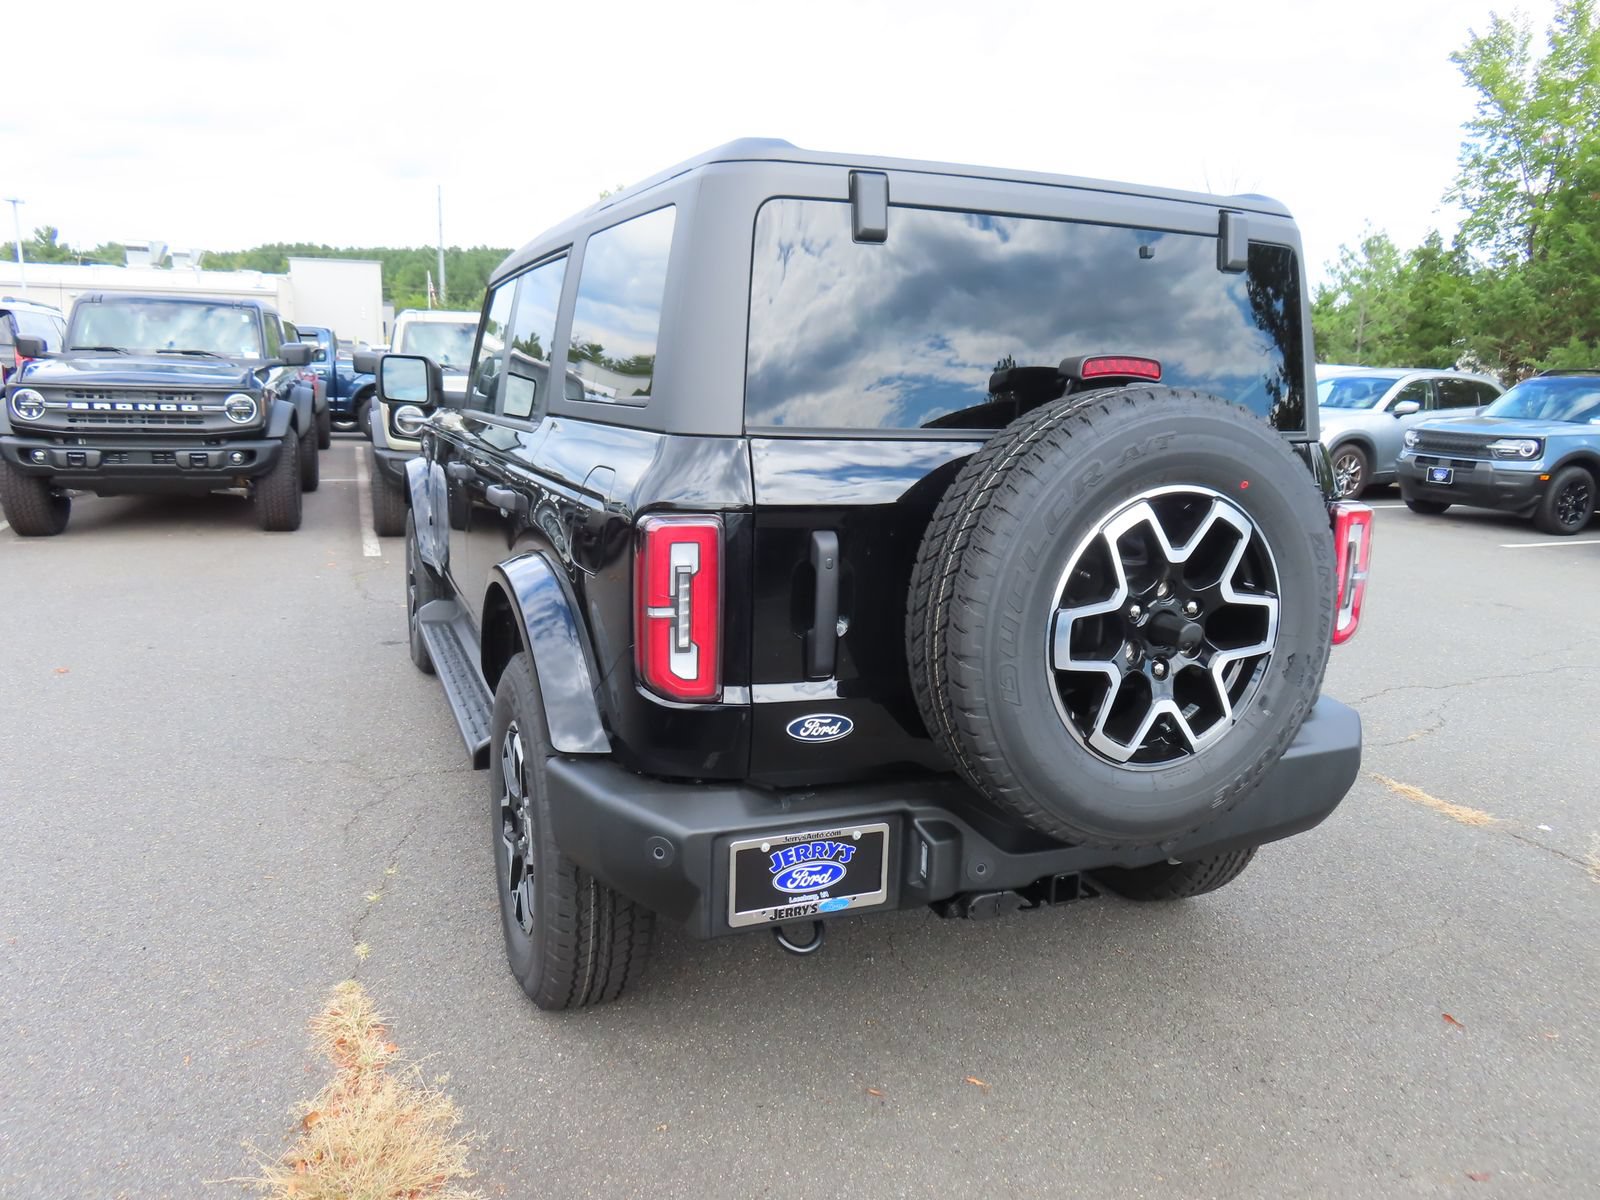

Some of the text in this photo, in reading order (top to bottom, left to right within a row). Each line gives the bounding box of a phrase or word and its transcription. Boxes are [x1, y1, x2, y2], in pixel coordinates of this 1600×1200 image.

[70, 402, 199, 412] BRONCO
[799, 718, 842, 737] Ford
[768, 840, 857, 874] JERRY'S
[786, 866, 834, 889] Ford
[769, 903, 818, 920] JERRY'S
